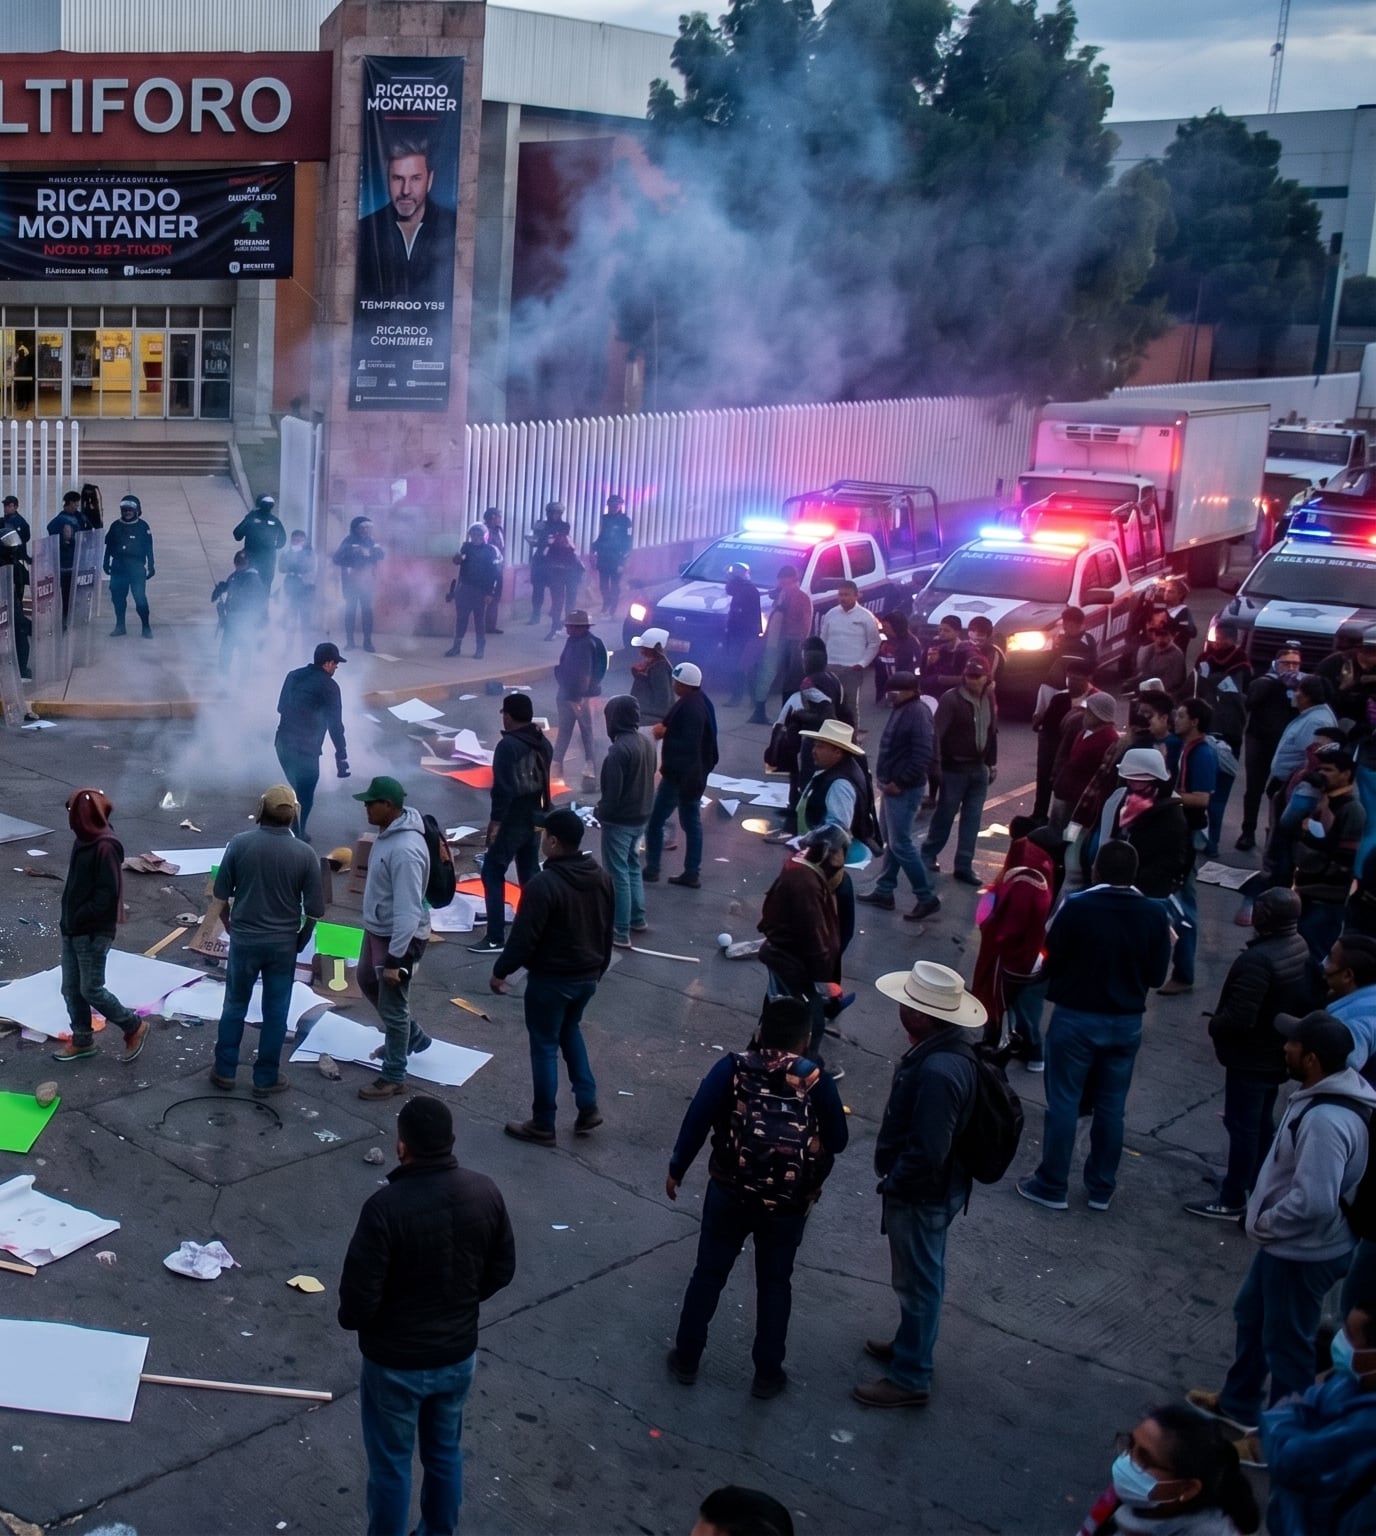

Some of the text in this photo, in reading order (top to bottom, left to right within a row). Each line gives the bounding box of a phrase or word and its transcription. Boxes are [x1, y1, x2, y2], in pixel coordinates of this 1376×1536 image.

[376, 83, 449, 97] RICARDO
[367, 98, 457, 111] MONTANER
[37, 188, 181, 212] RICARDO
[18, 215, 199, 239] MONTANER
[376, 326, 428, 335] RICARDO
